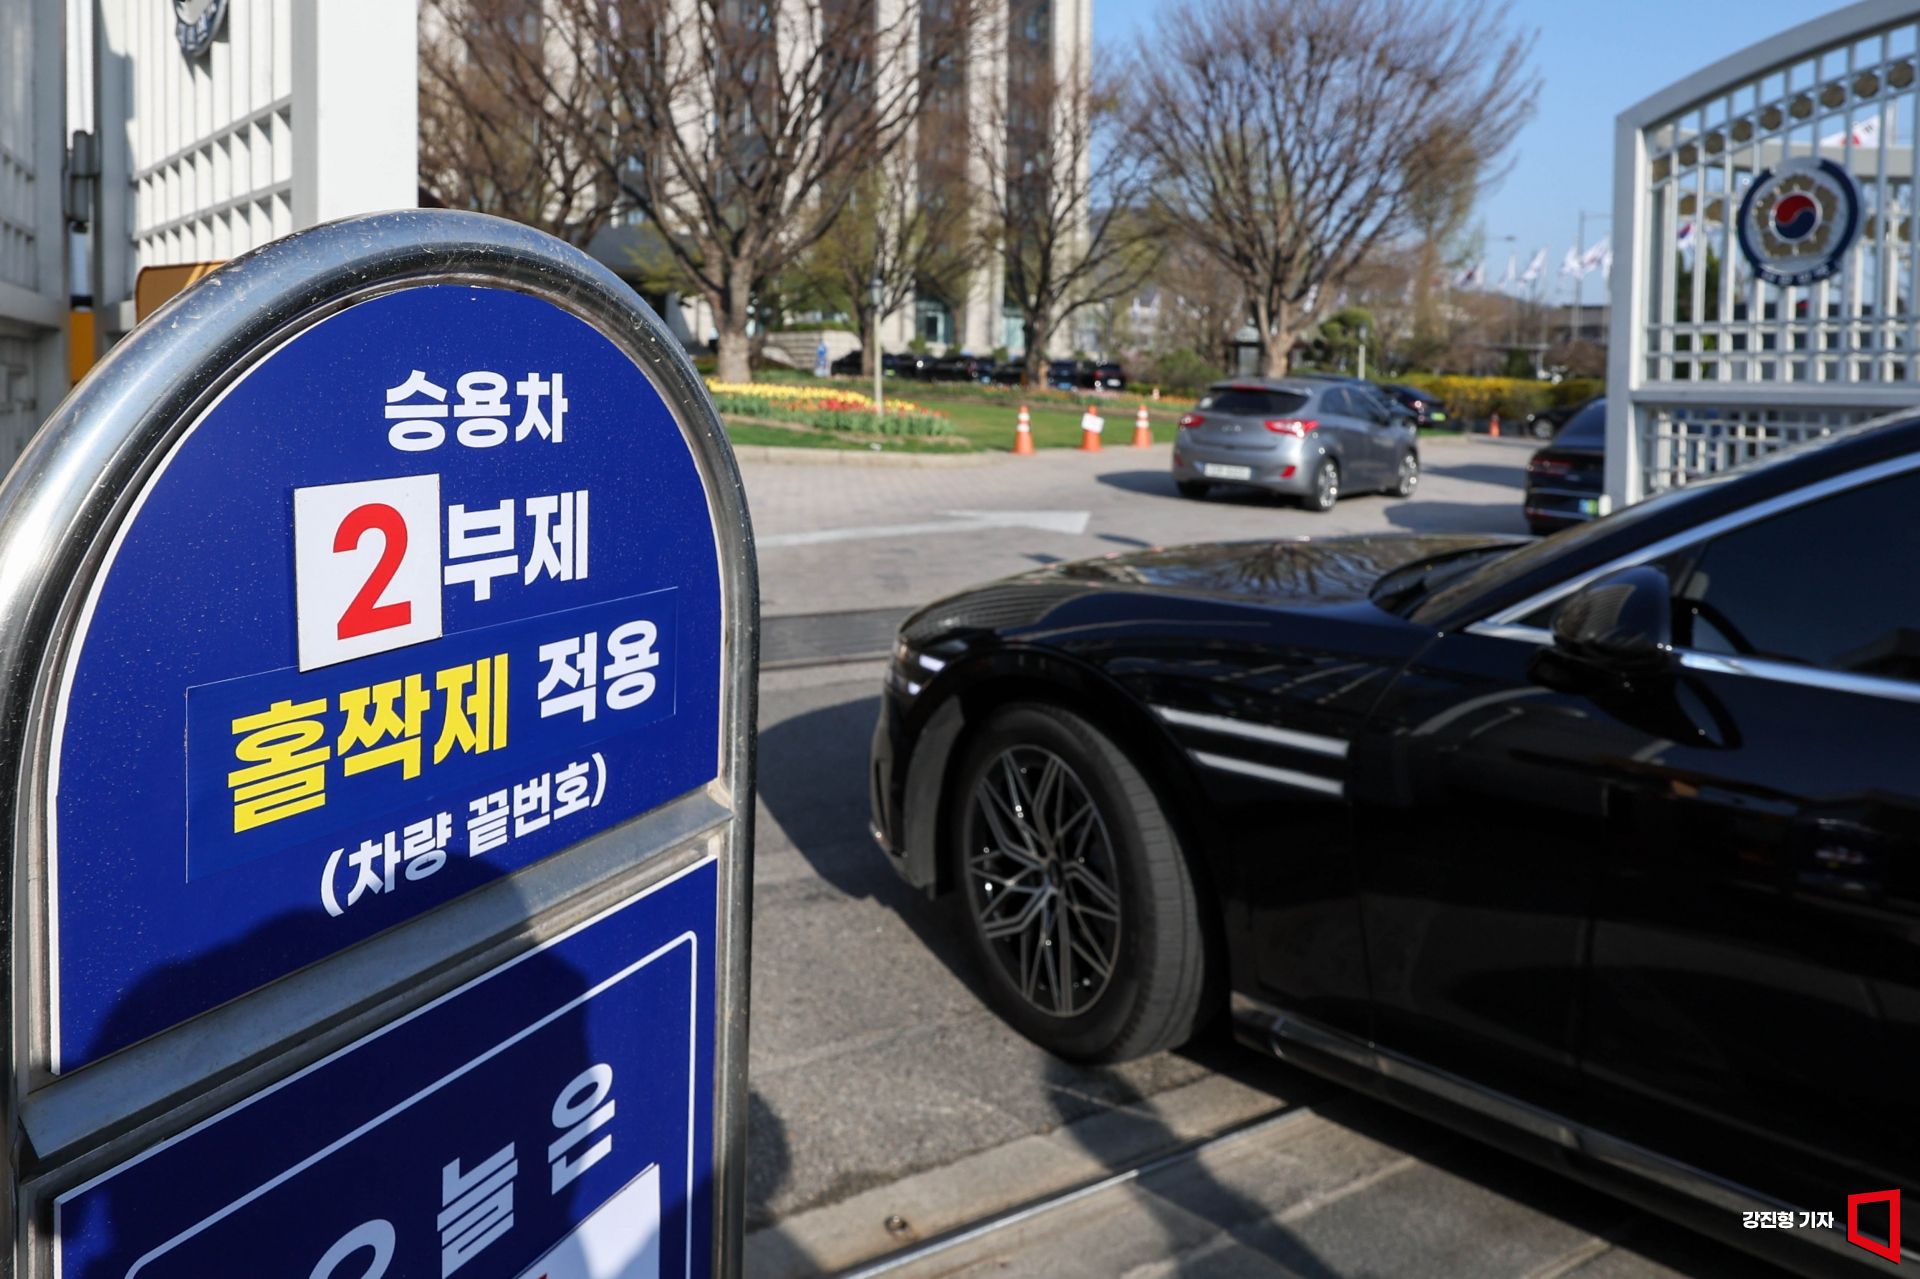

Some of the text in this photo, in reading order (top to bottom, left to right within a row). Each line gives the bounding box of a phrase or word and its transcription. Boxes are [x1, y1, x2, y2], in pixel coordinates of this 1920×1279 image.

[384, 369, 569, 452] 승용차
[332, 489, 590, 641] 2부제
[228, 620, 660, 833] 홀짝제 적용
[320, 752, 607, 917] (차량 끝번호)
